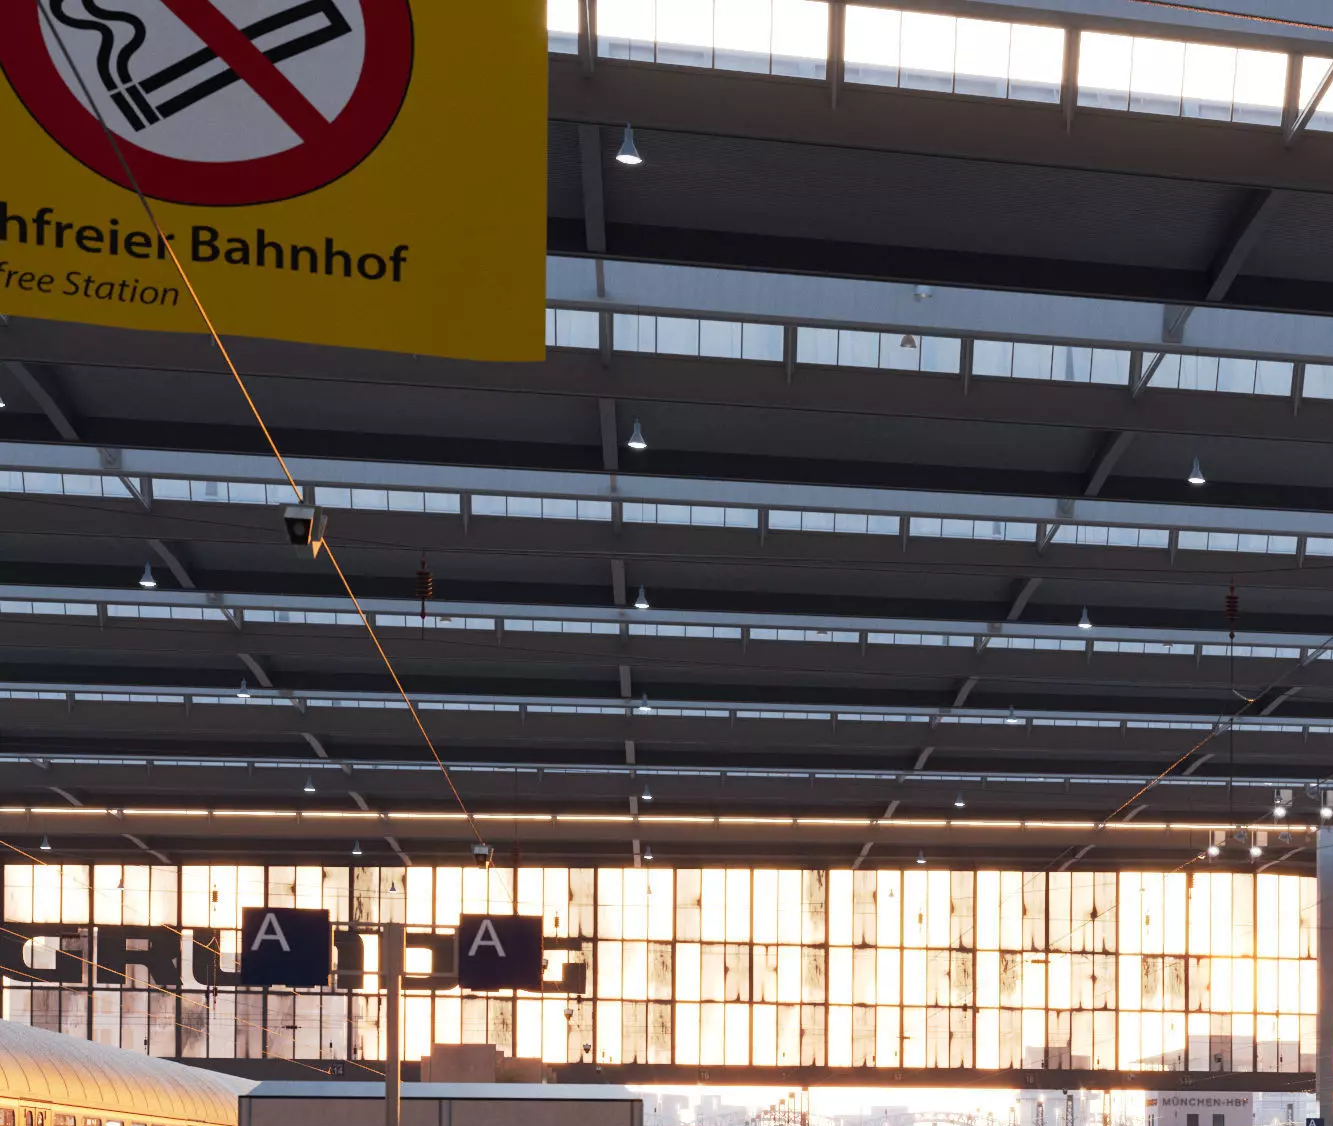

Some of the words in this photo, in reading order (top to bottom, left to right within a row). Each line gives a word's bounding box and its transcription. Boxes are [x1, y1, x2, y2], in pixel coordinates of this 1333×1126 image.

[190, 225, 410, 283] Bahnhof
[62, 270, 180, 306] Station
[250, 913, 292, 952] A
[467, 919, 506, 957] A
